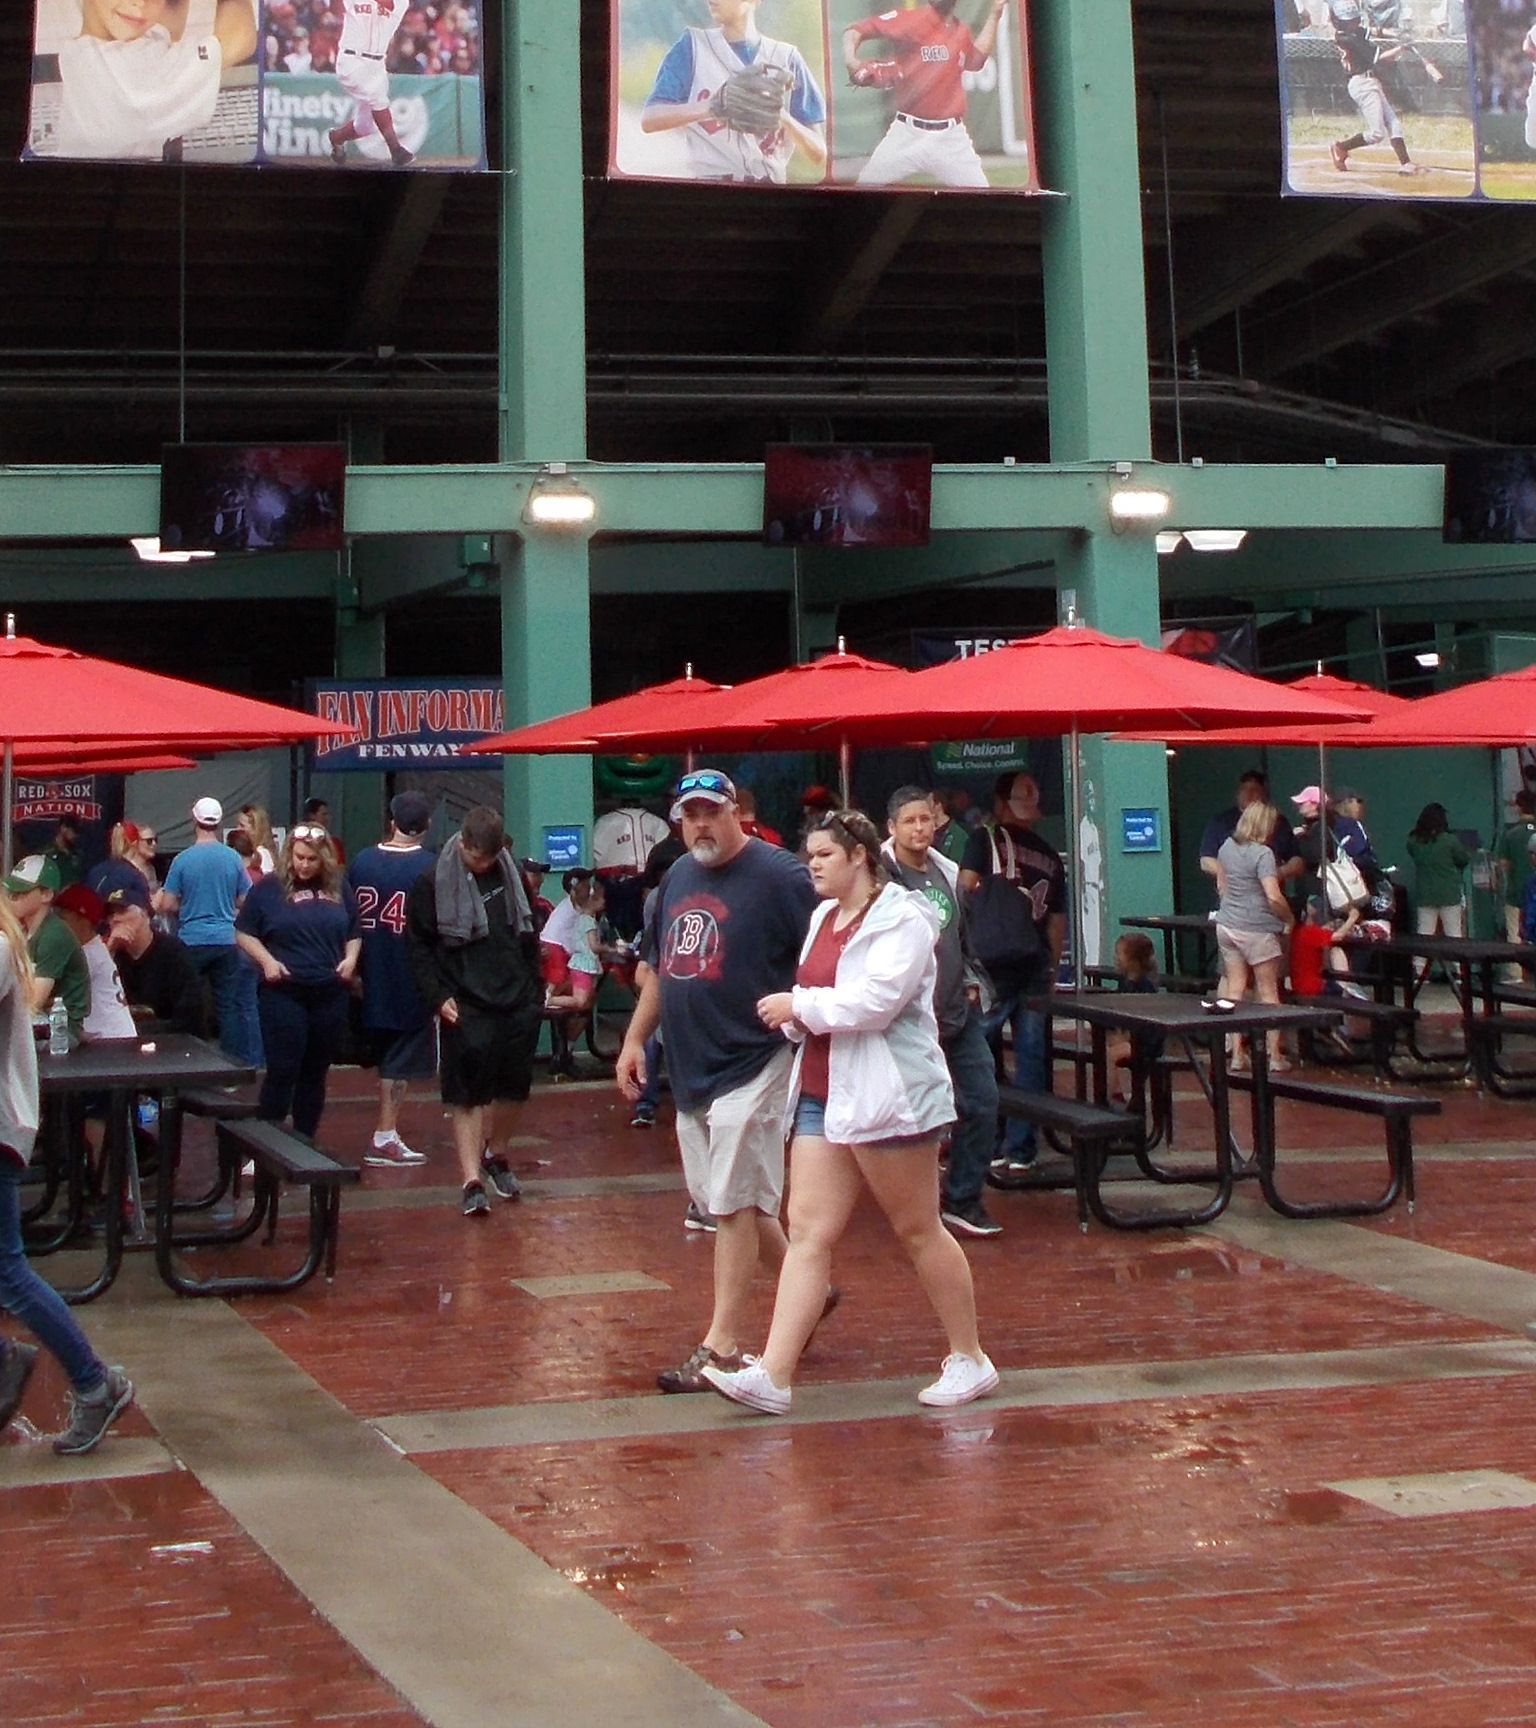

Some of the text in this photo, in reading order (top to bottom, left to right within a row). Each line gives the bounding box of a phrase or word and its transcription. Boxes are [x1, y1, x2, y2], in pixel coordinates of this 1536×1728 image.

[358, 743, 464, 758] FENWAY
[962, 741, 1016, 757] National
[18, 783, 92, 799] RED SOX
[23, 802, 86, 816] NATION
[356, 885, 407, 934] 24
[677, 914, 704, 955] B
